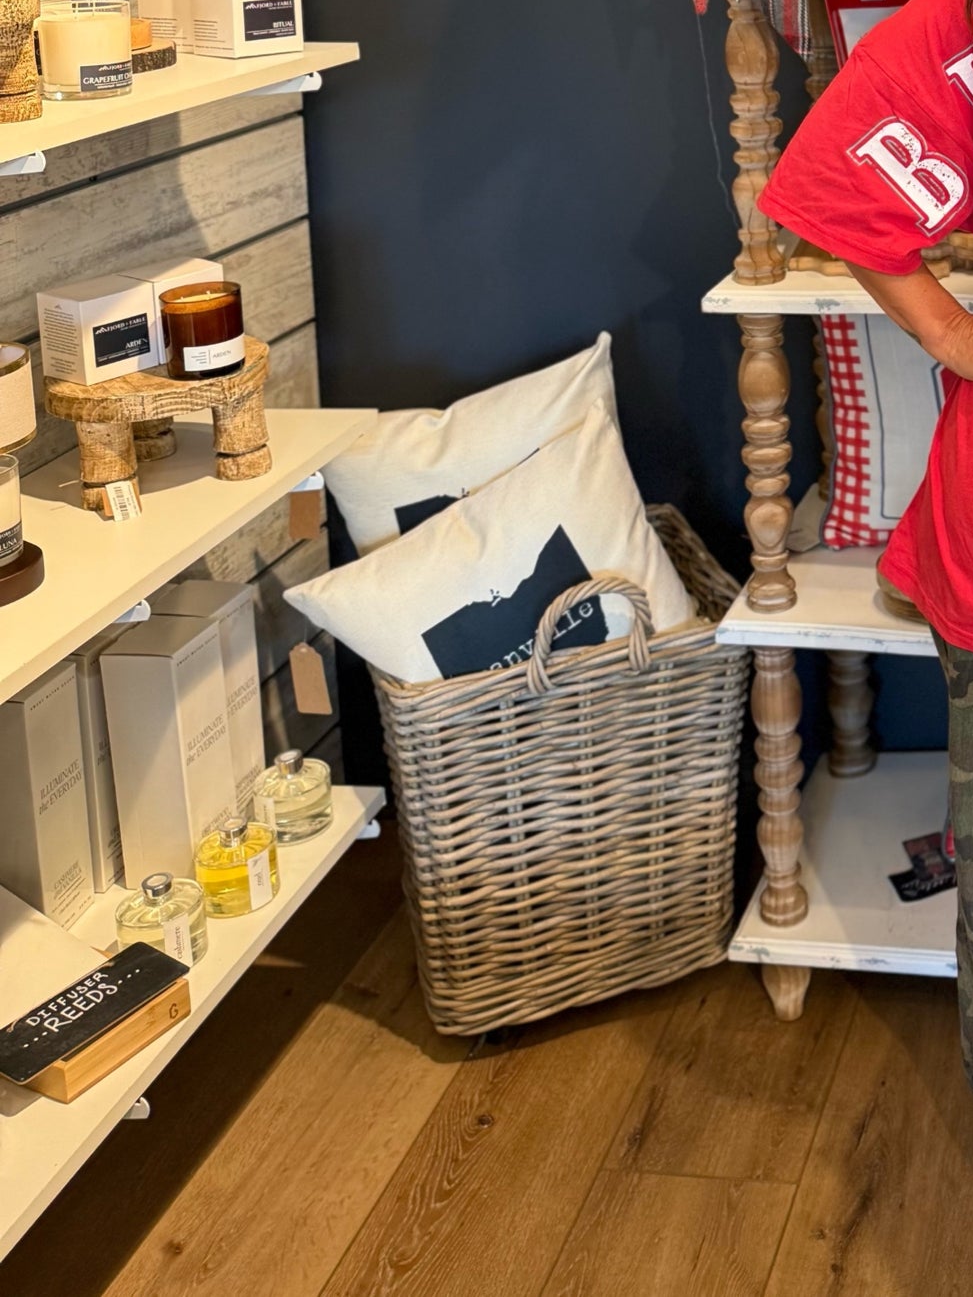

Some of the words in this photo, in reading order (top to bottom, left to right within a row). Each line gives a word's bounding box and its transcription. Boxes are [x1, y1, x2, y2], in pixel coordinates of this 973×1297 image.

[273, 21, 294, 29] RITUAL
[83, 73, 124, 84] GRAPEFRUIT
[107, 322, 125, 333] FJORD
[129, 317, 146, 328] FABLE
[125, 338, 148, 349] ARDEN
[212, 349, 232, 359] ARDEN
[187, 713, 225, 753] ILLUMINATE
[196, 724, 228, 762] EVERYDAY
[40, 757, 80, 801] ILLUMINATE
[49, 771, 83, 809] EVERYDAY
[172, 925, 183, 960] cashmere
[26, 971, 109, 1027] DIFFUSER
[43, 981, 119, 1034] REEDS
